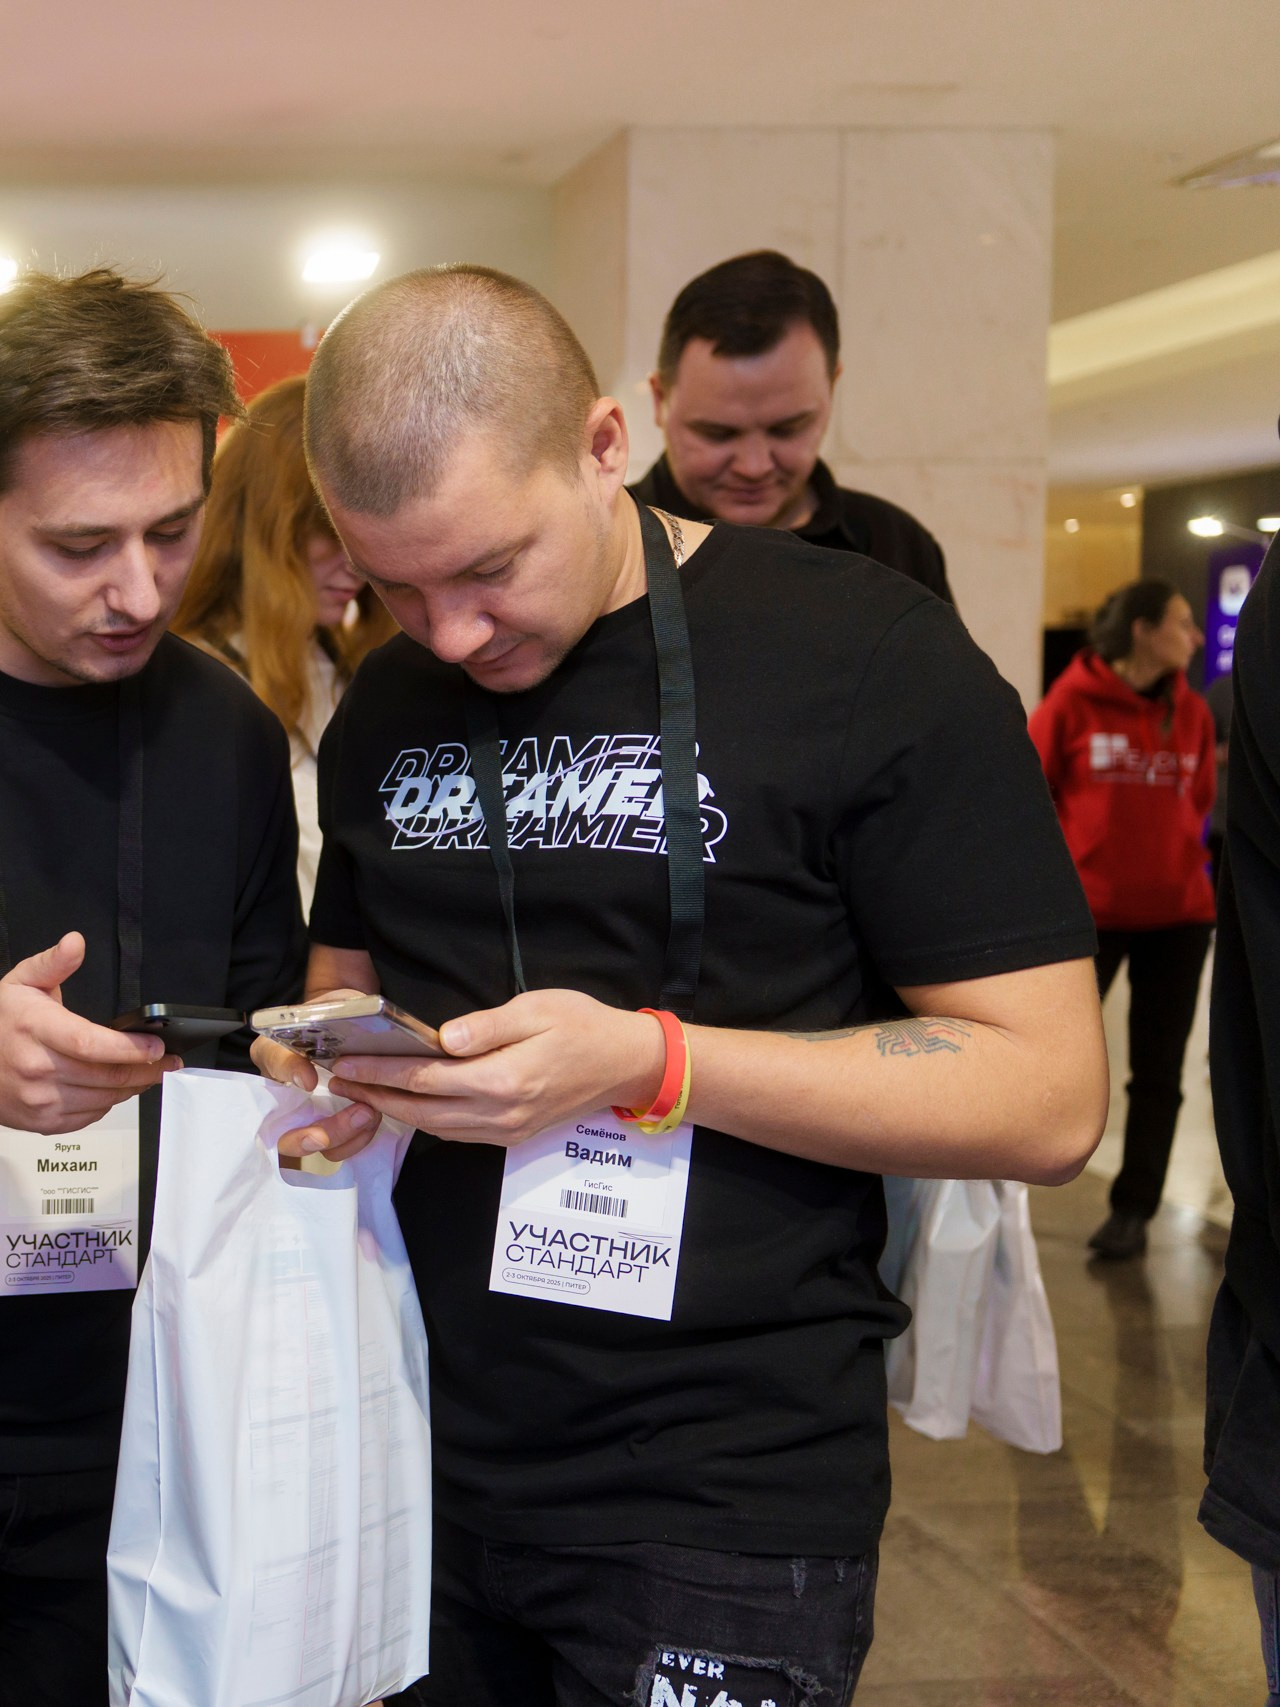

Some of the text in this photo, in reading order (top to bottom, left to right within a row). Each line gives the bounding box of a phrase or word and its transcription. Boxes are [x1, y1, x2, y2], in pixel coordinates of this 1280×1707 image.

[576, 1124, 627, 1142] Семёнов
[54, 1143, 81, 1151] Ярута
[565, 1141, 633, 1168] Вадим
[37, 1158, 98, 1172] Михаил
[583, 1179, 613, 1192] ГисГис
[6, 1229, 132, 1250] УЧАСТНИК
[509, 1221, 672, 1267] УЧАСТНИК
[6, 1248, 117, 1268] СТАНДАРТ
[505, 1244, 650, 1283] СТАНДАРТ
[516, 1273, 546, 1284] ОКТЯБРЯ
[546, 1278, 561, 1286] 2025
[565, 1281, 587, 1290] ПИТЕР
[662, 1652, 725, 1680] EVER
